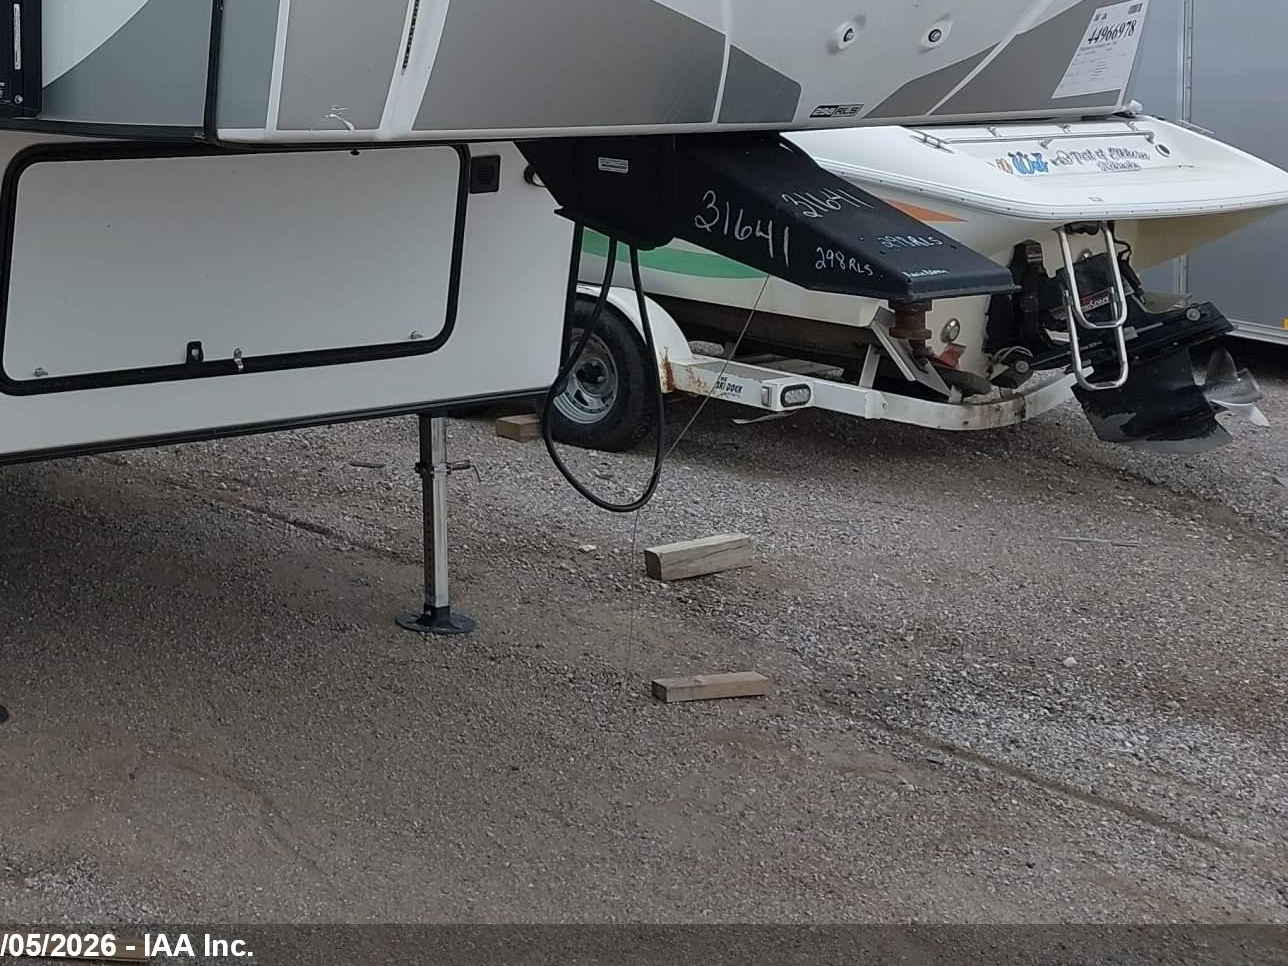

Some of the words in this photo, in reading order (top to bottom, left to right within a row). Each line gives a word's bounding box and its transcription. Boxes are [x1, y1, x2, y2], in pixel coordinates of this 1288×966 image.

[1087, 19, 1137, 45] 44966978
[835, 106, 859, 115] RLS
[780, 187, 876, 218] 31641
[694, 189, 790, 267] 31641
